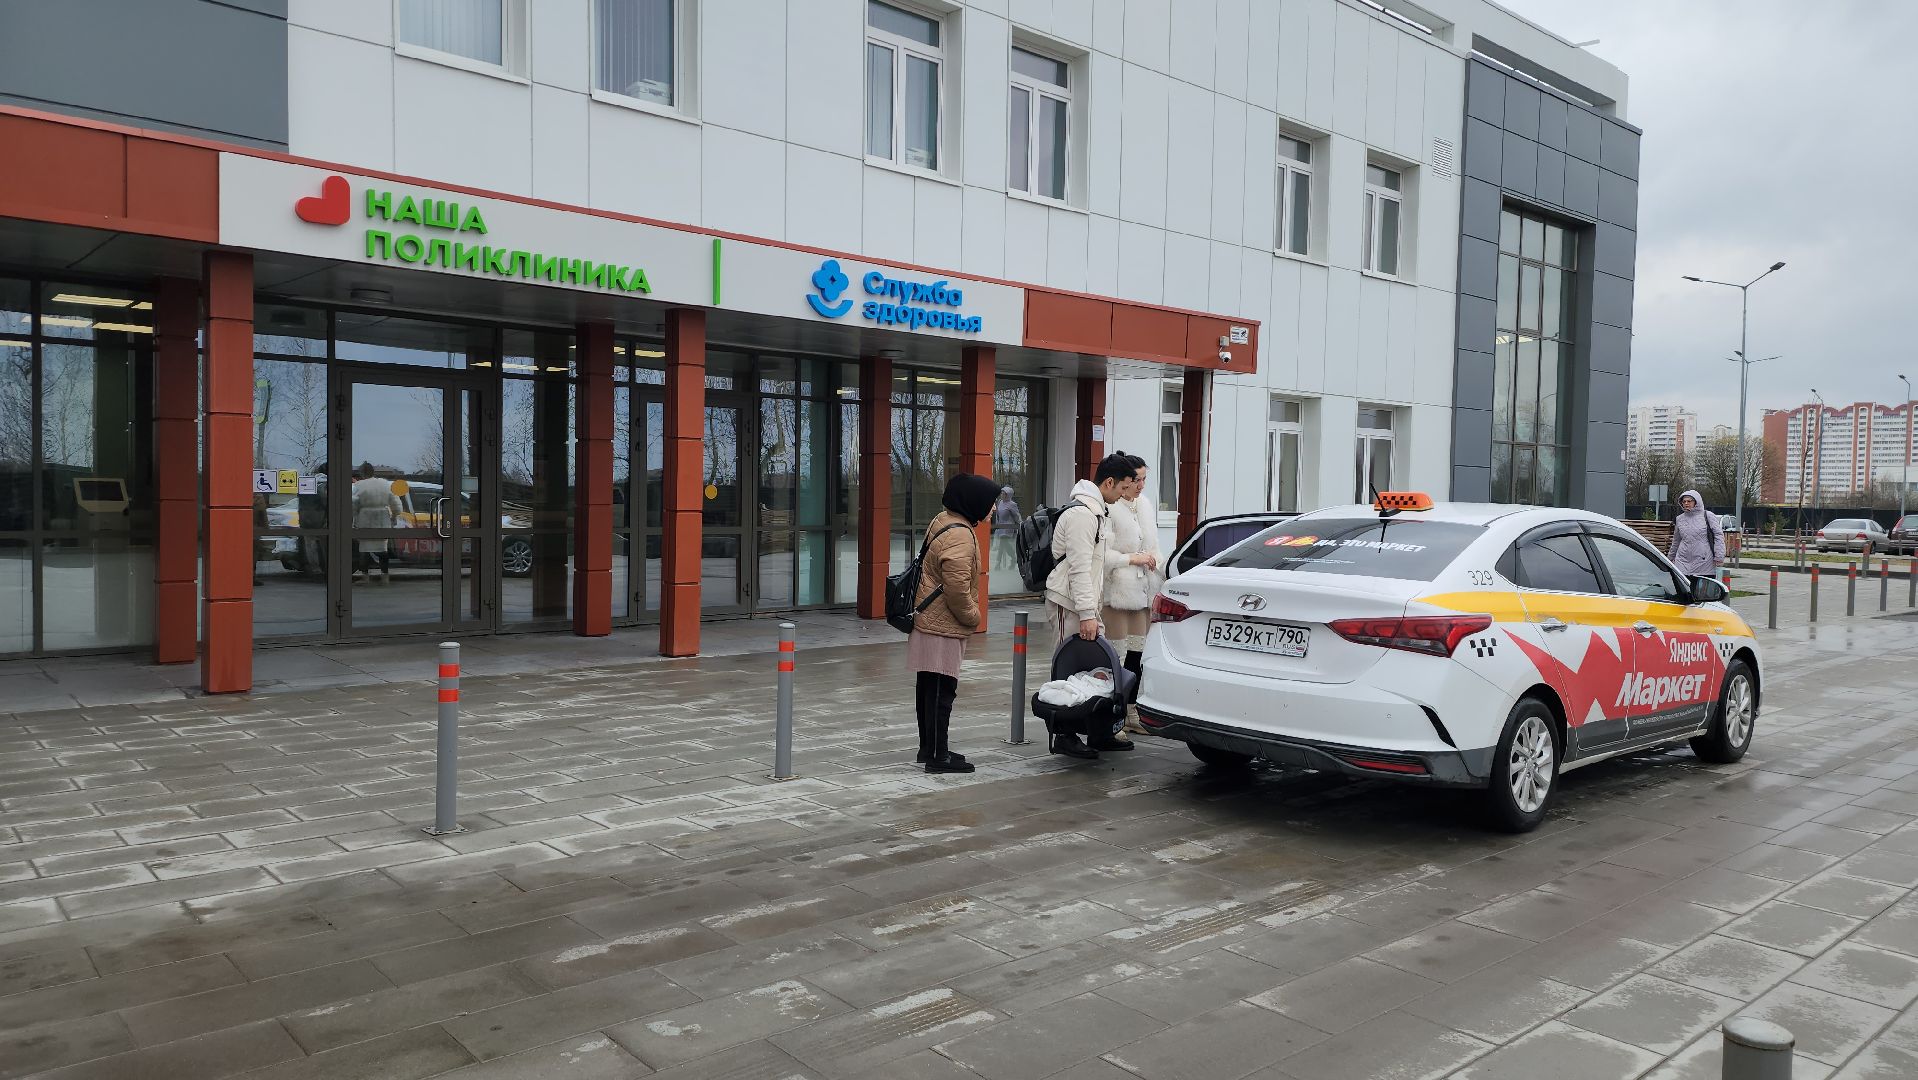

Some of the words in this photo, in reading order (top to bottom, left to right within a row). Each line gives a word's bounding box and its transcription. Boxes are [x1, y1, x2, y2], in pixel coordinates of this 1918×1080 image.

[366, 188, 488, 235] НАША
[366, 229, 652, 294] ПОЛИКЛИНИКА
[863, 271, 963, 307] Служба
[862, 301, 982, 333] здоровья
[1365, 541, 1427, 553] МАРКЕТ
[1467, 569, 1494, 586] 329
[1278, 627, 1304, 645] 790
[1669, 637, 1709, 667] Яндекс
[1613, 671, 1707, 711] Маркет
